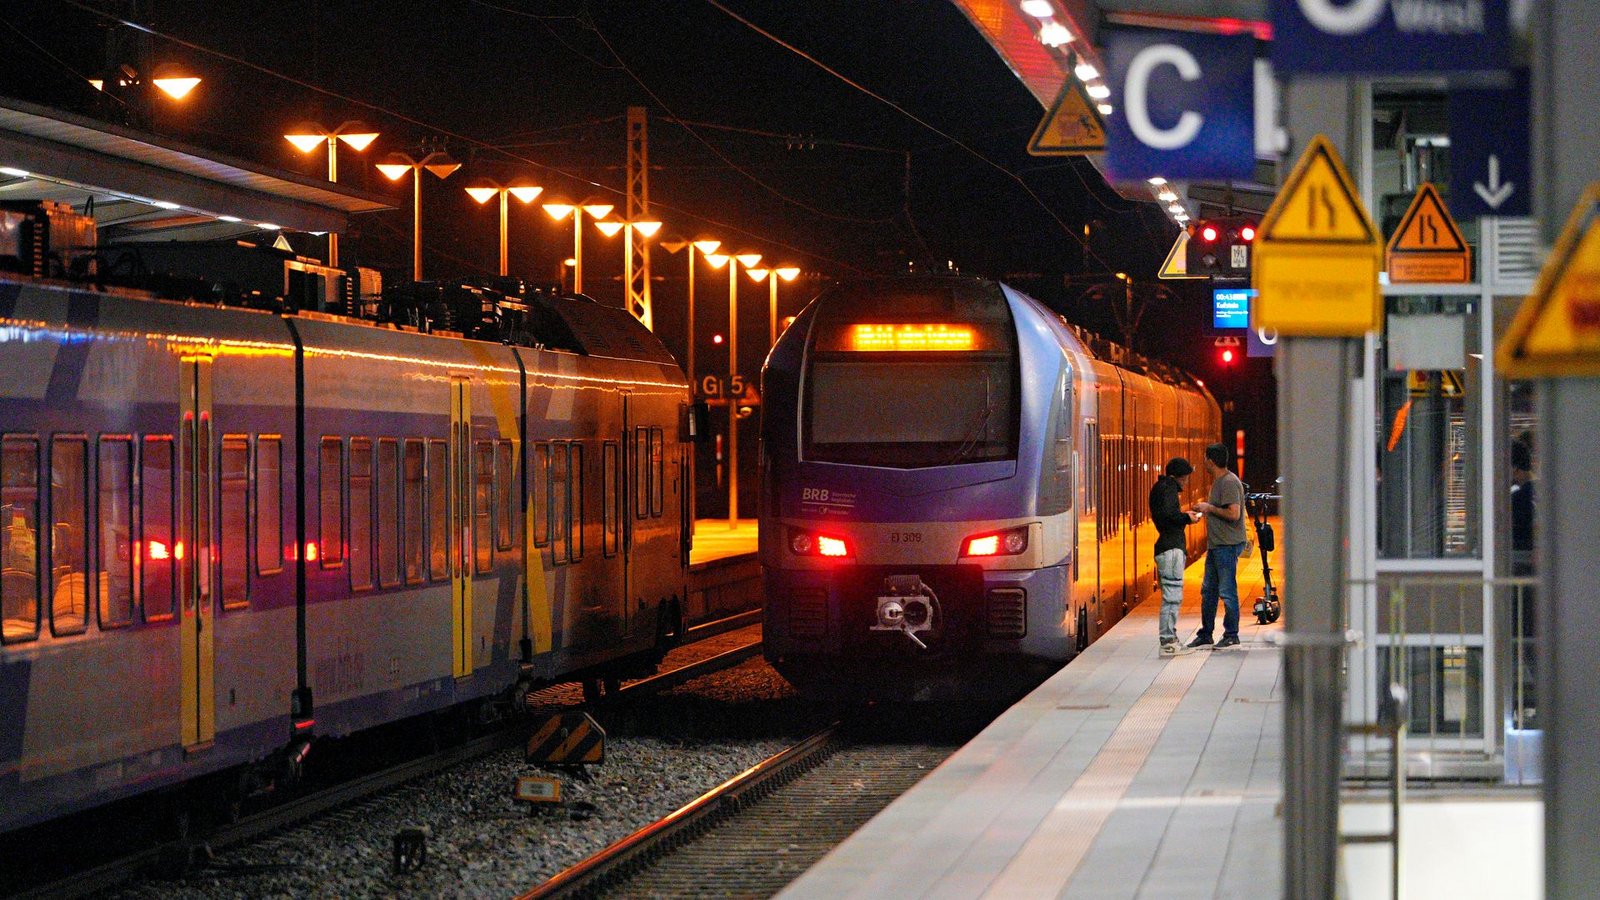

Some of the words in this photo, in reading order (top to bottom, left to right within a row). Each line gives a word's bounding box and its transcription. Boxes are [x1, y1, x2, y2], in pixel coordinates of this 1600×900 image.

[1124, 44, 1202, 149] C
[731, 375, 743, 395] 5
[802, 487, 829, 501] BRB
